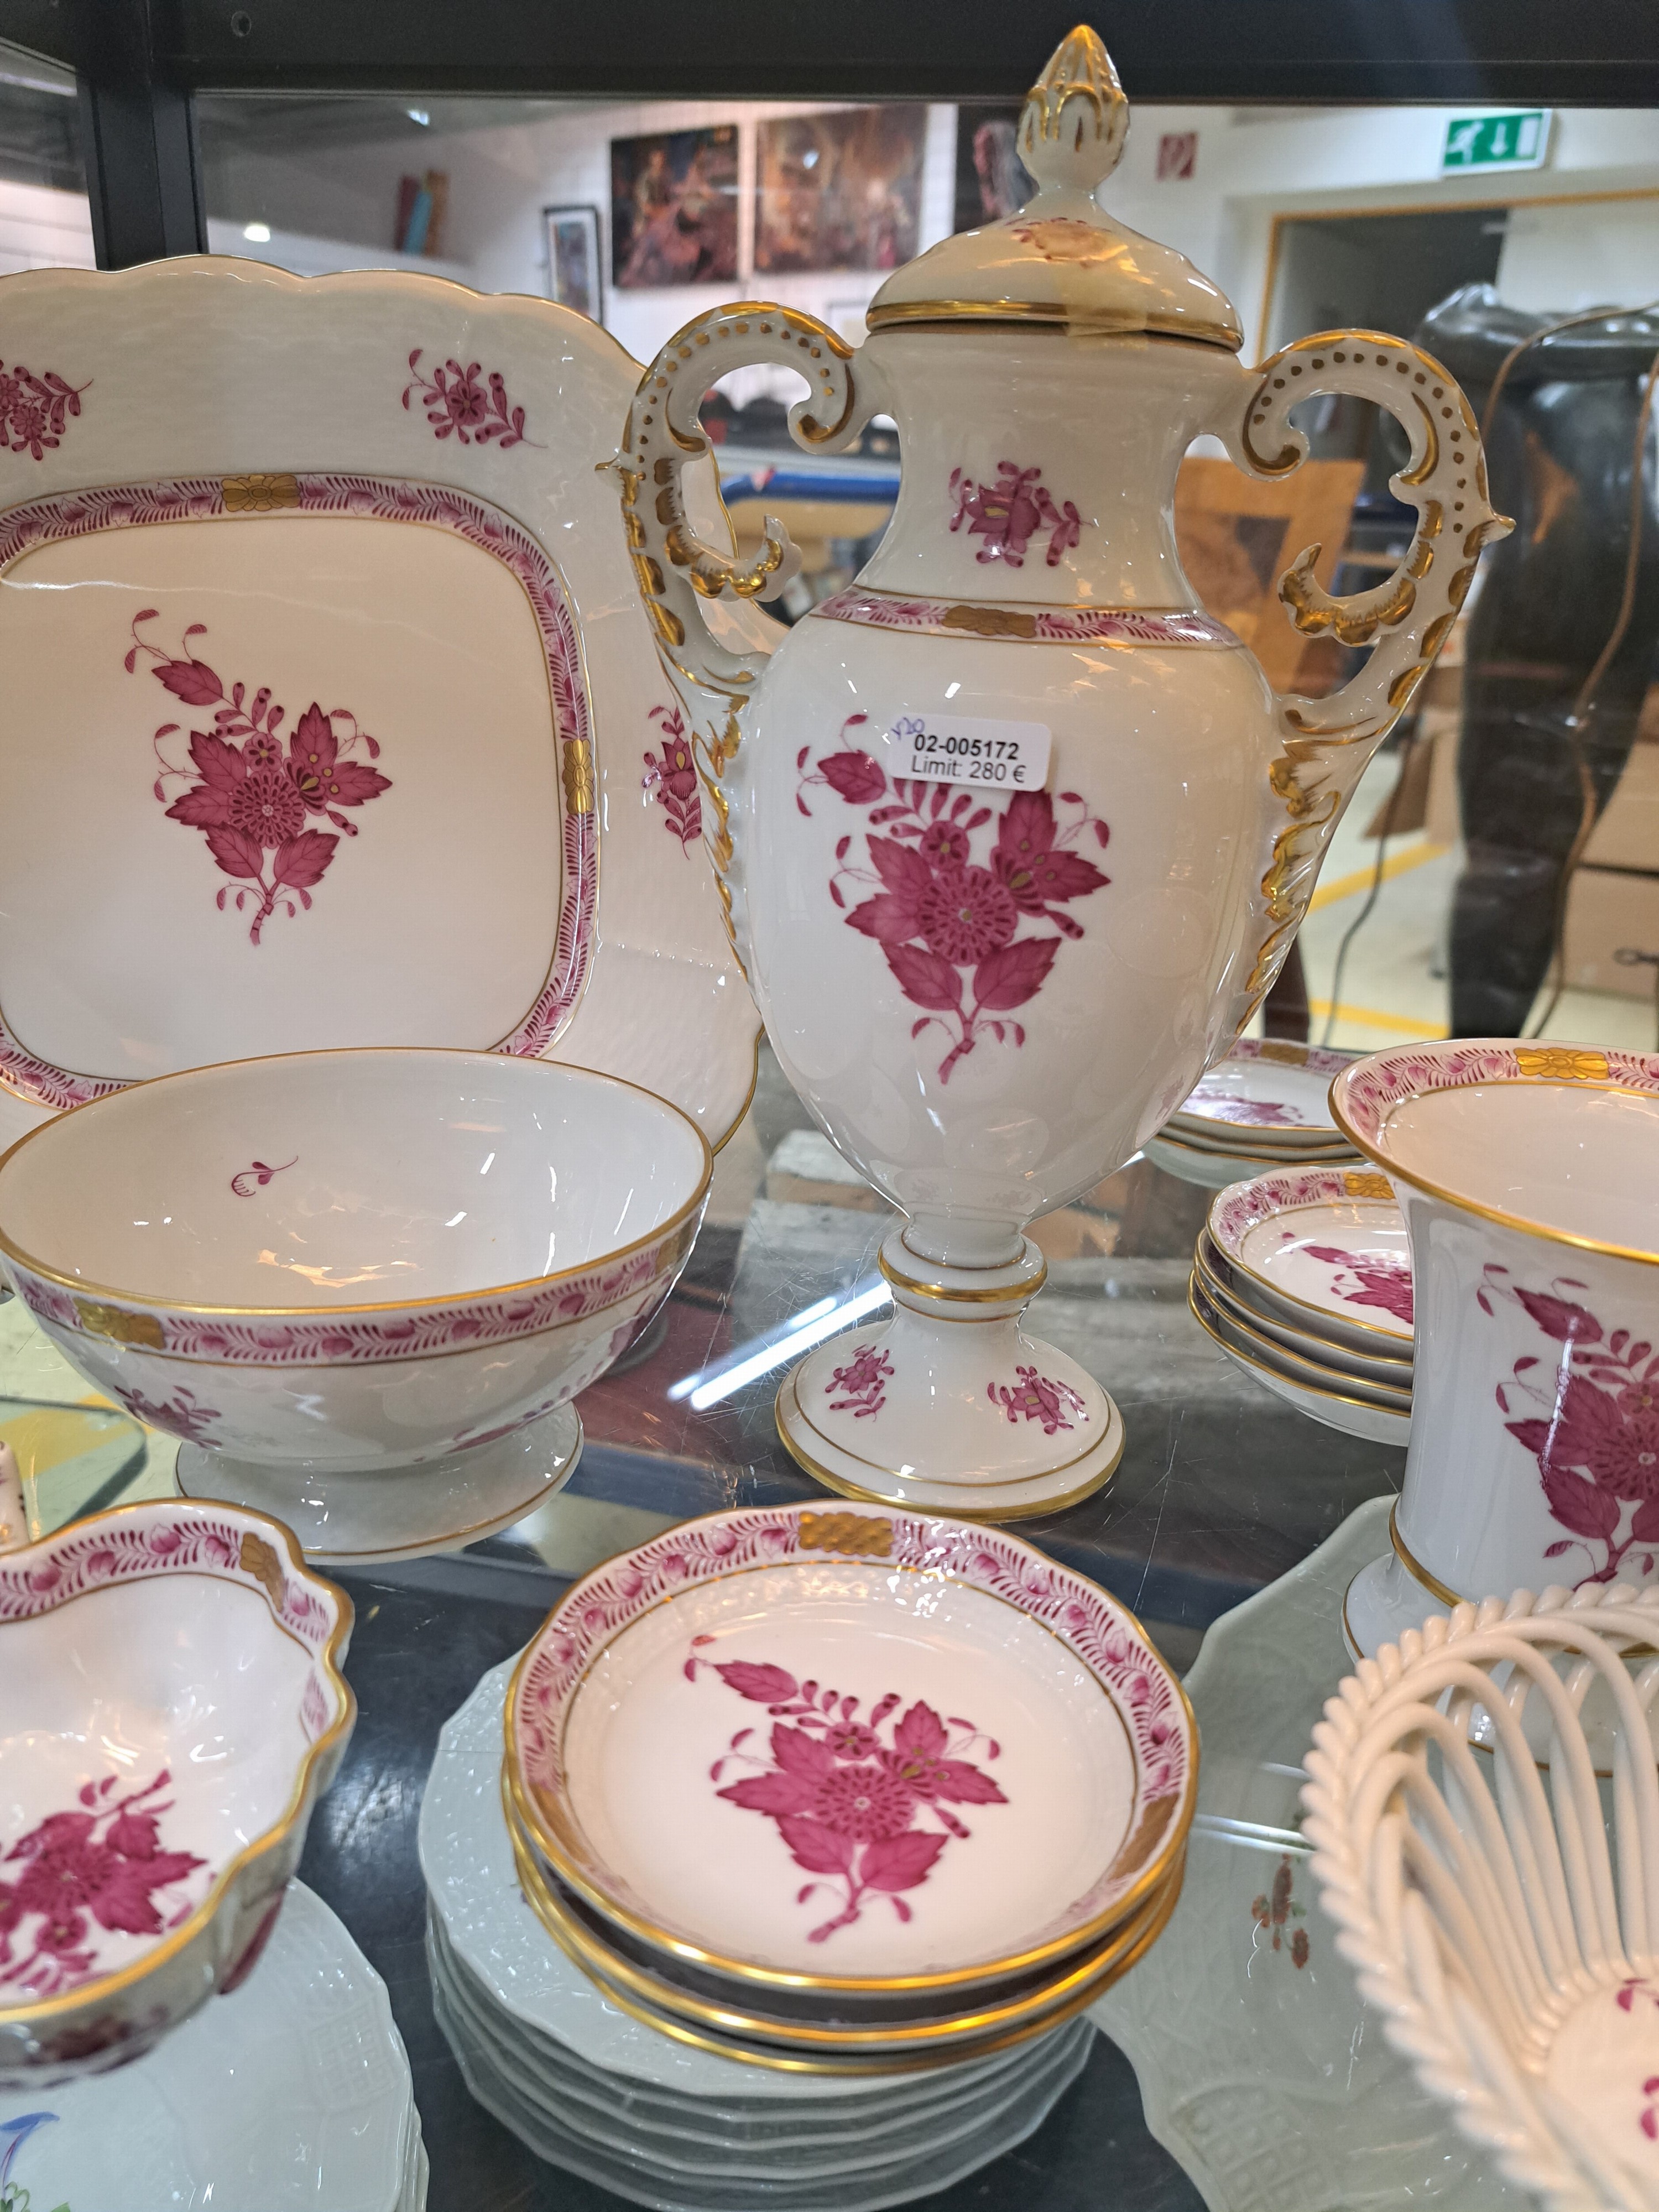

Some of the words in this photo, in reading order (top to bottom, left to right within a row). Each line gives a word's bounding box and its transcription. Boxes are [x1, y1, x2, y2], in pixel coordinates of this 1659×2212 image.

[914, 734, 1019, 760] 02-005172
[969, 761, 1007, 781] 280
[1013, 765, 1027, 783] €
